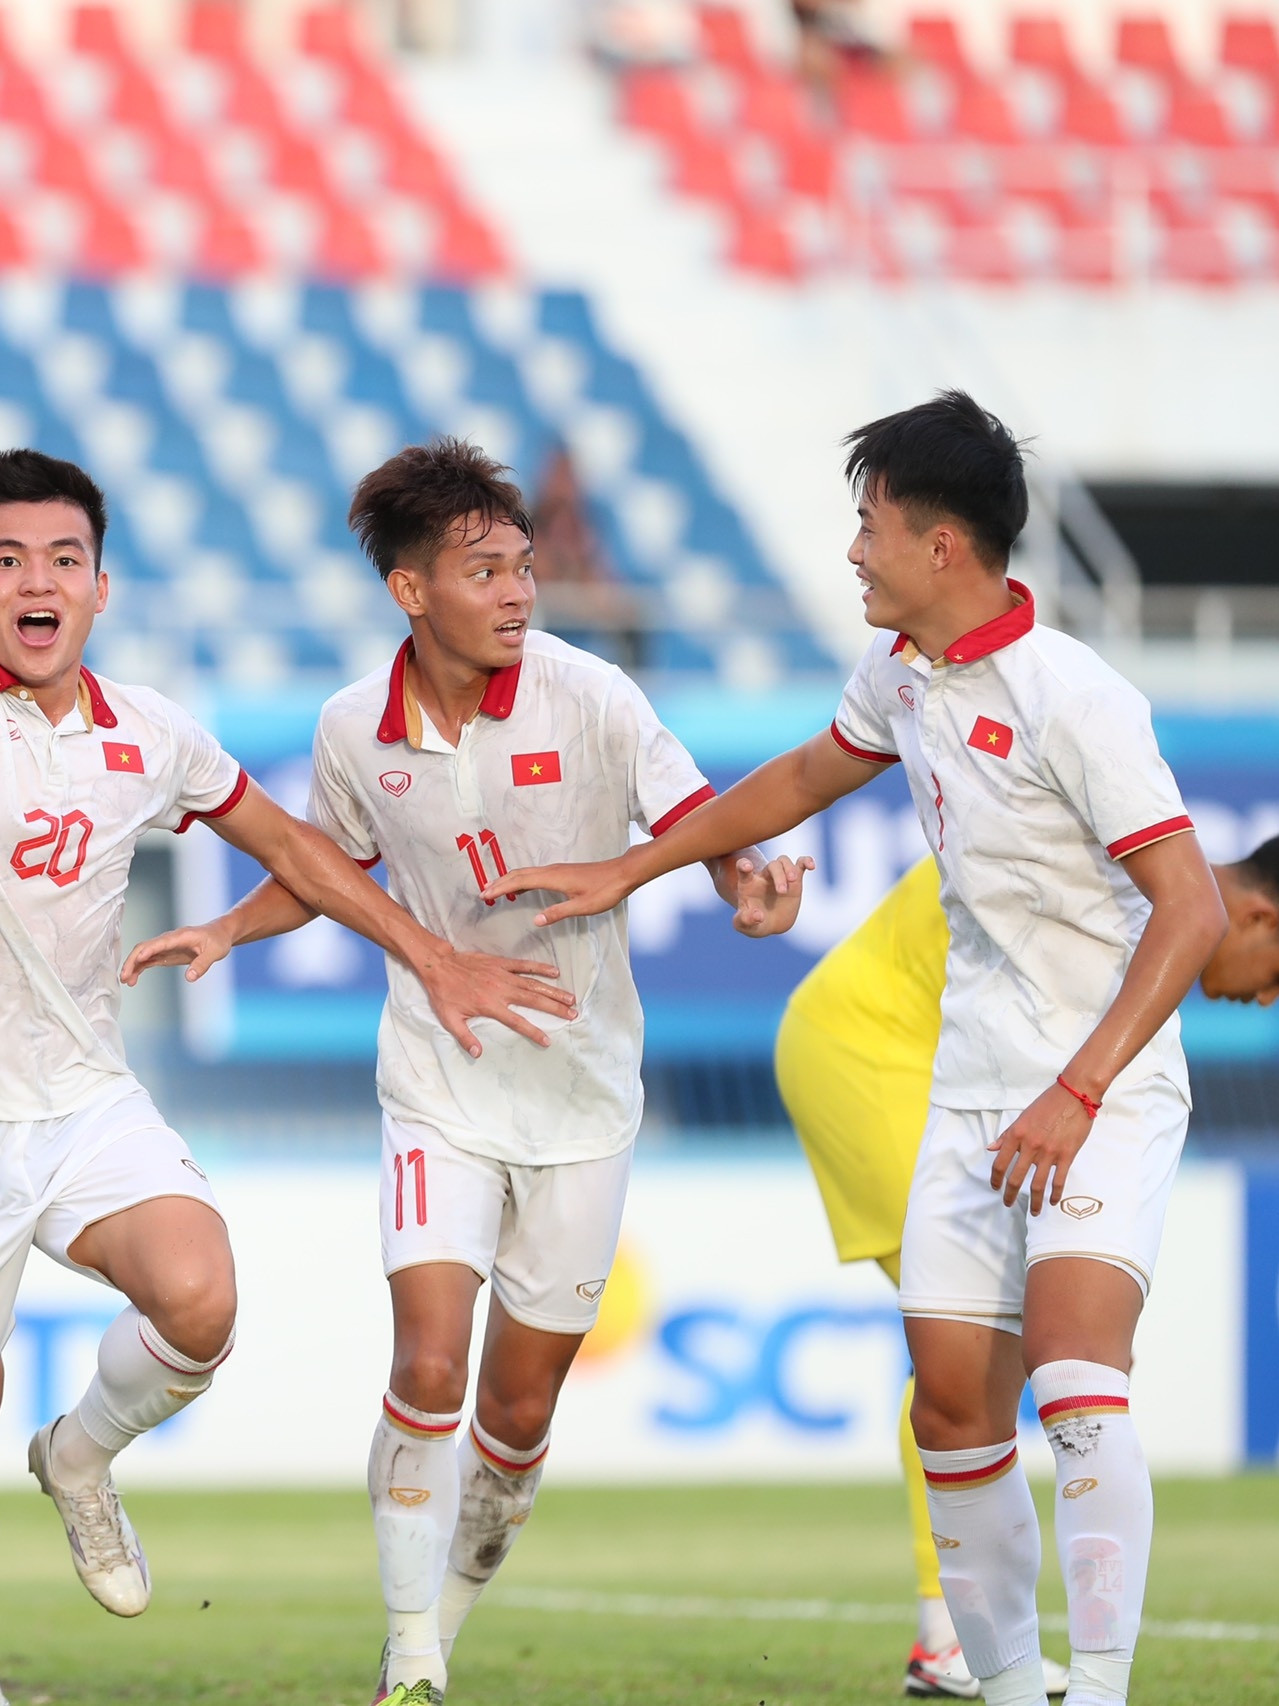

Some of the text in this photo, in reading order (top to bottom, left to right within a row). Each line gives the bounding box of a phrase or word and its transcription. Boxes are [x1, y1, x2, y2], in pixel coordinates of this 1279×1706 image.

[10, 807, 94, 888] 20
[455, 828, 517, 907] 11
[393, 1147, 428, 1232] 11
